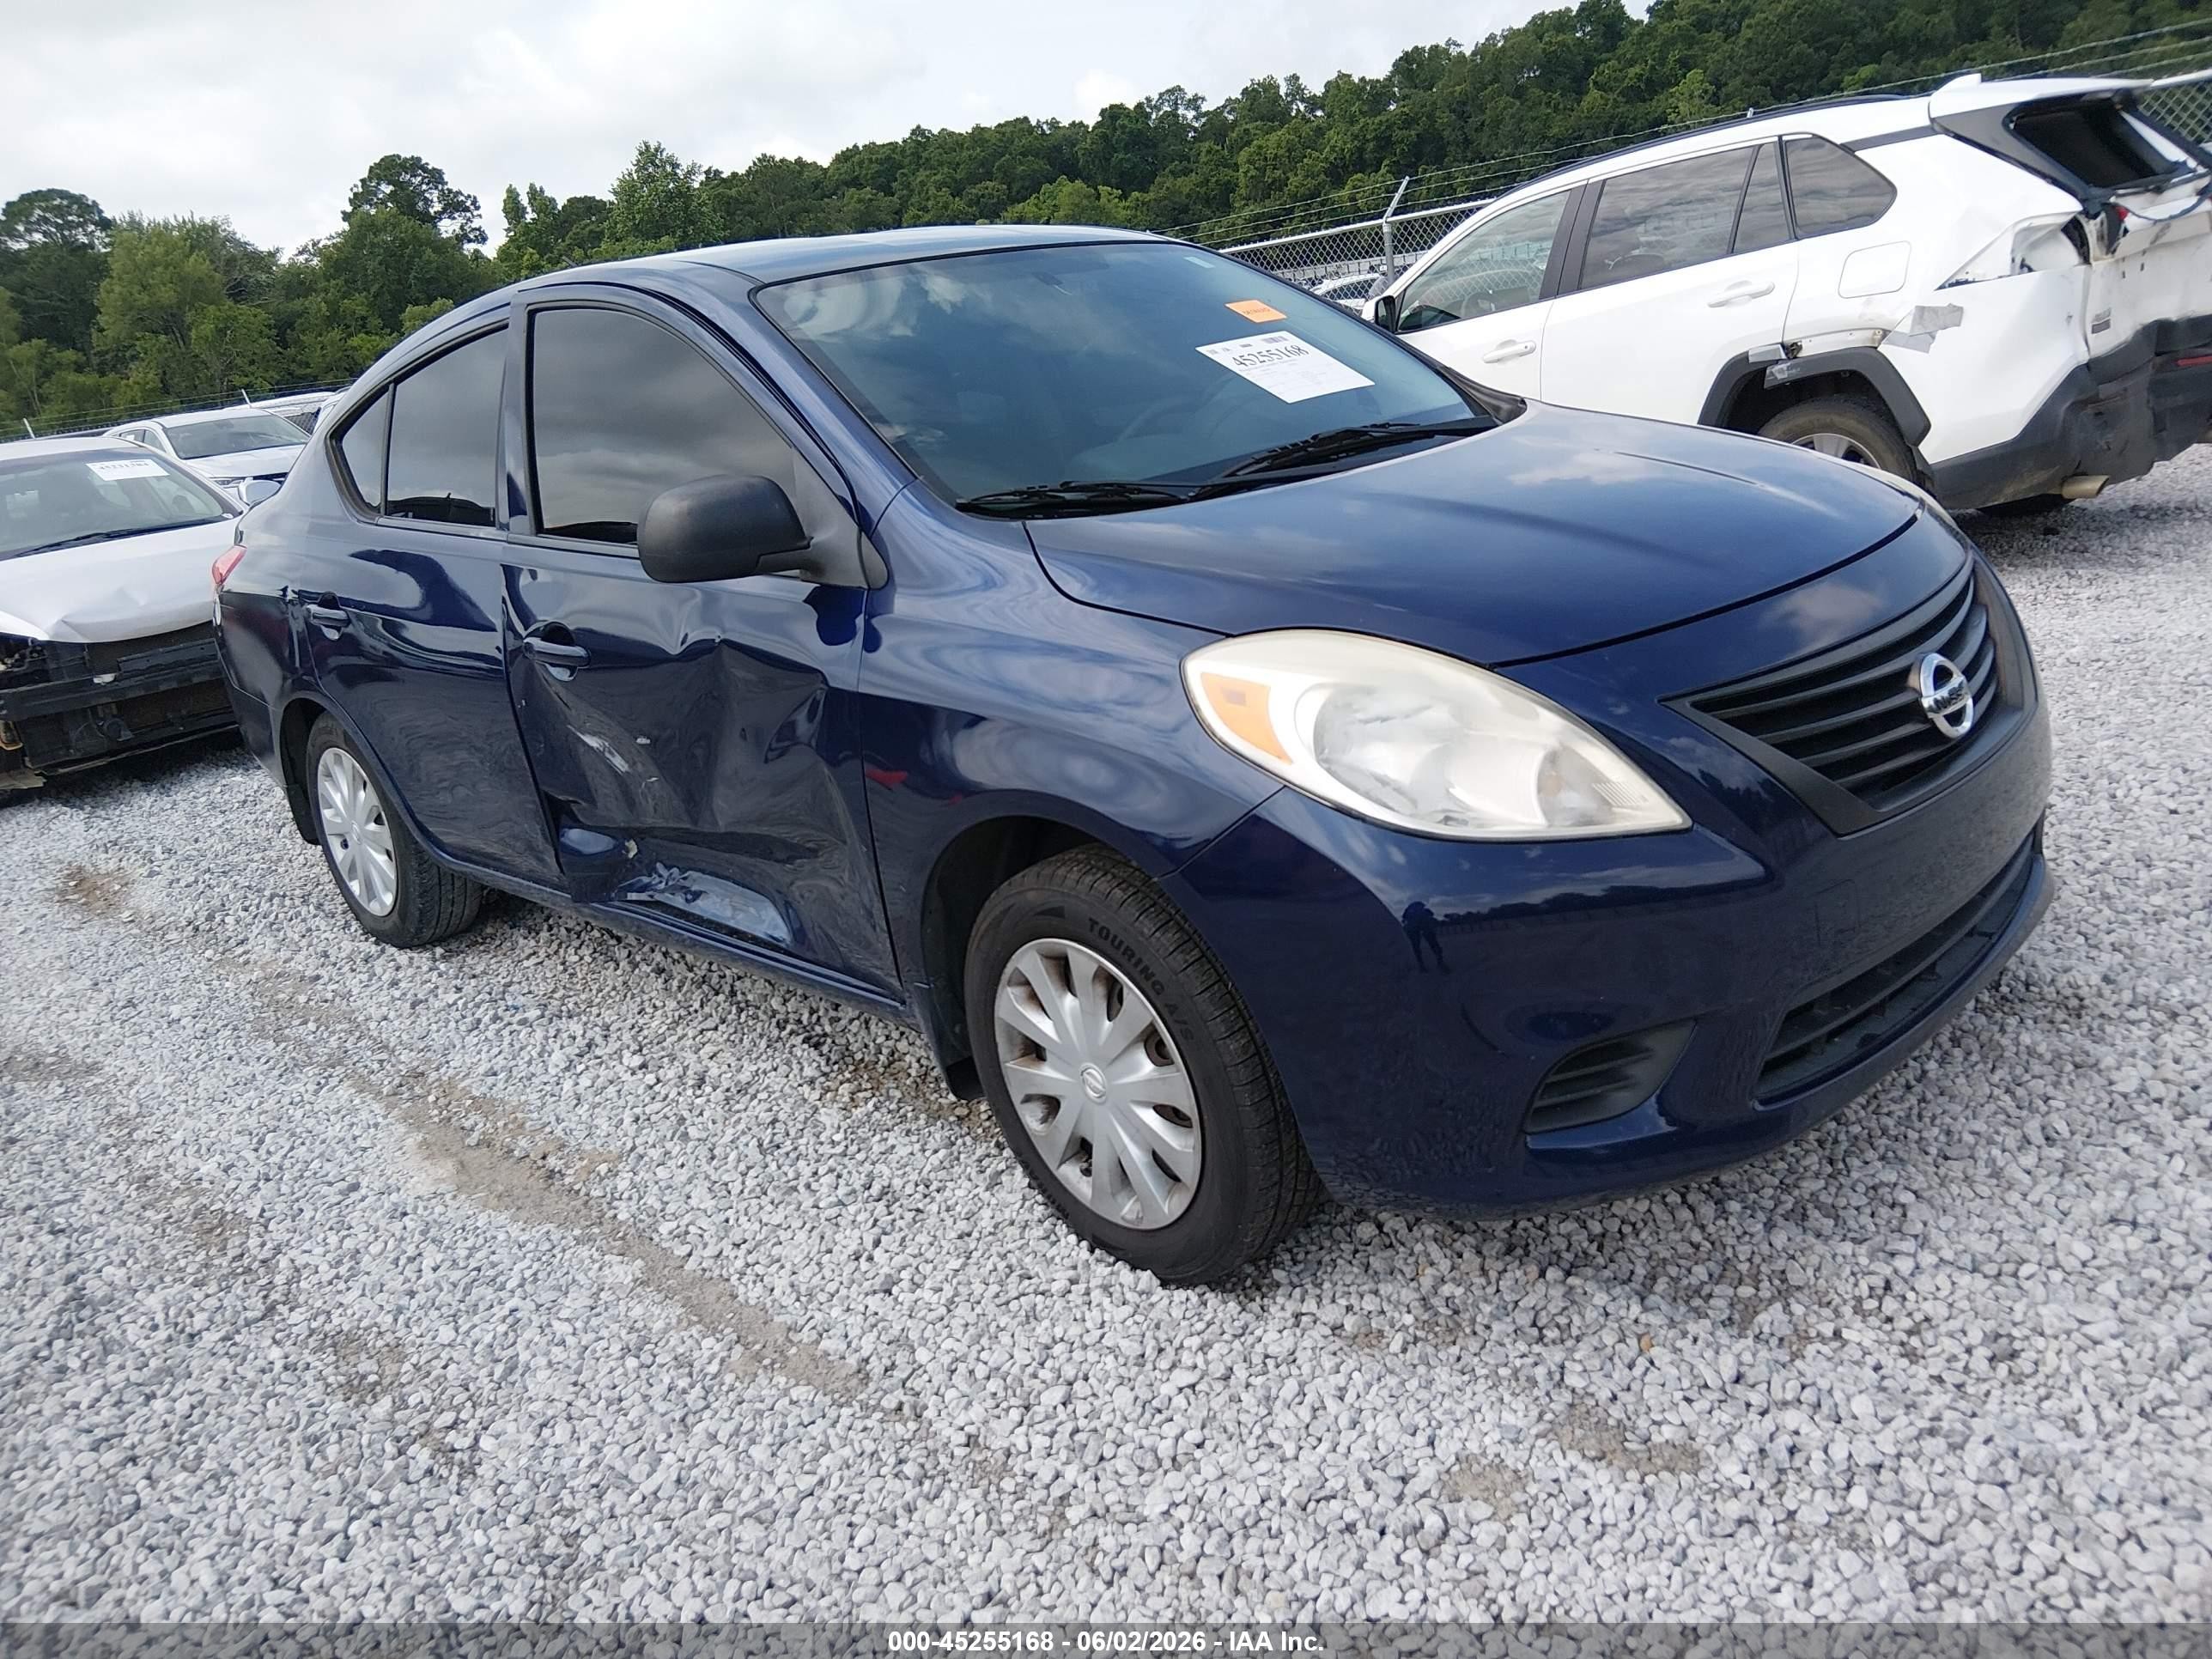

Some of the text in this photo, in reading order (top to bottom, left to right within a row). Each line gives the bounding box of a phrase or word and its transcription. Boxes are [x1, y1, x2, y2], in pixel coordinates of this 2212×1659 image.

[1231, 344, 1310, 368] 45255168
[1088, 917, 1194, 1041] TOURING A/S
